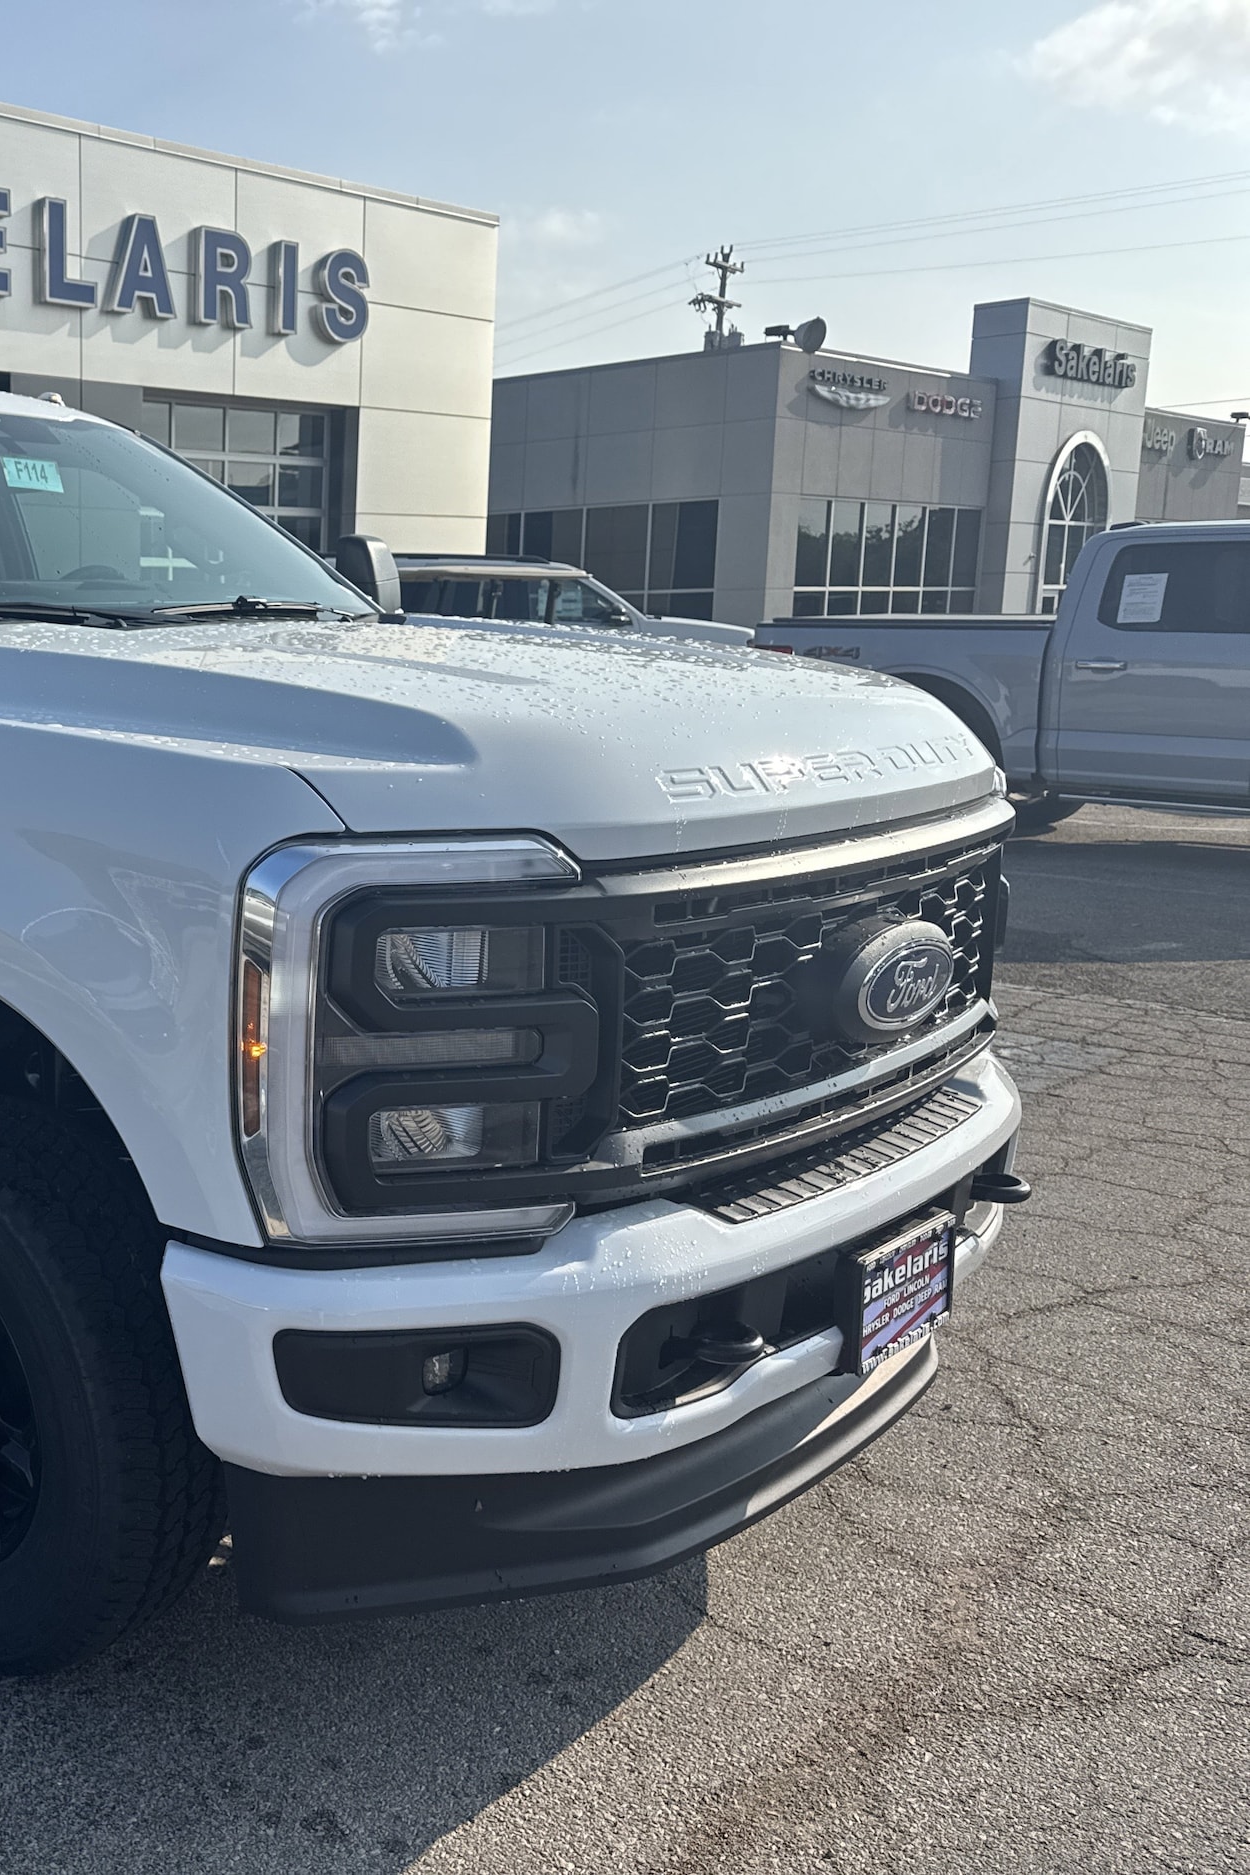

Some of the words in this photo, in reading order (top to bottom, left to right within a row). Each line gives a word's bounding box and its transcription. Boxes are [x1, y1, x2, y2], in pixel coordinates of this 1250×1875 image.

[811, 369, 889, 391] CHRYSLER
[1054, 338, 1136, 388] Sakelaris
[911, 390, 983, 419] DODGE
[1144, 417, 1176, 459] Jeep
[1206, 438, 1235, 455] RAM
[14, 460, 48, 484] F114
[655, 750, 883, 803] SUPER
[876, 731, 974, 774] DUTY
[886, 956, 940, 1013] Ford
[883, 1291, 900, 1309] FORD
[904, 1274, 930, 1298] LINCOLN
[862, 1312, 890, 1338] HRYSLER
[893, 1298, 914, 1318] DODGE
